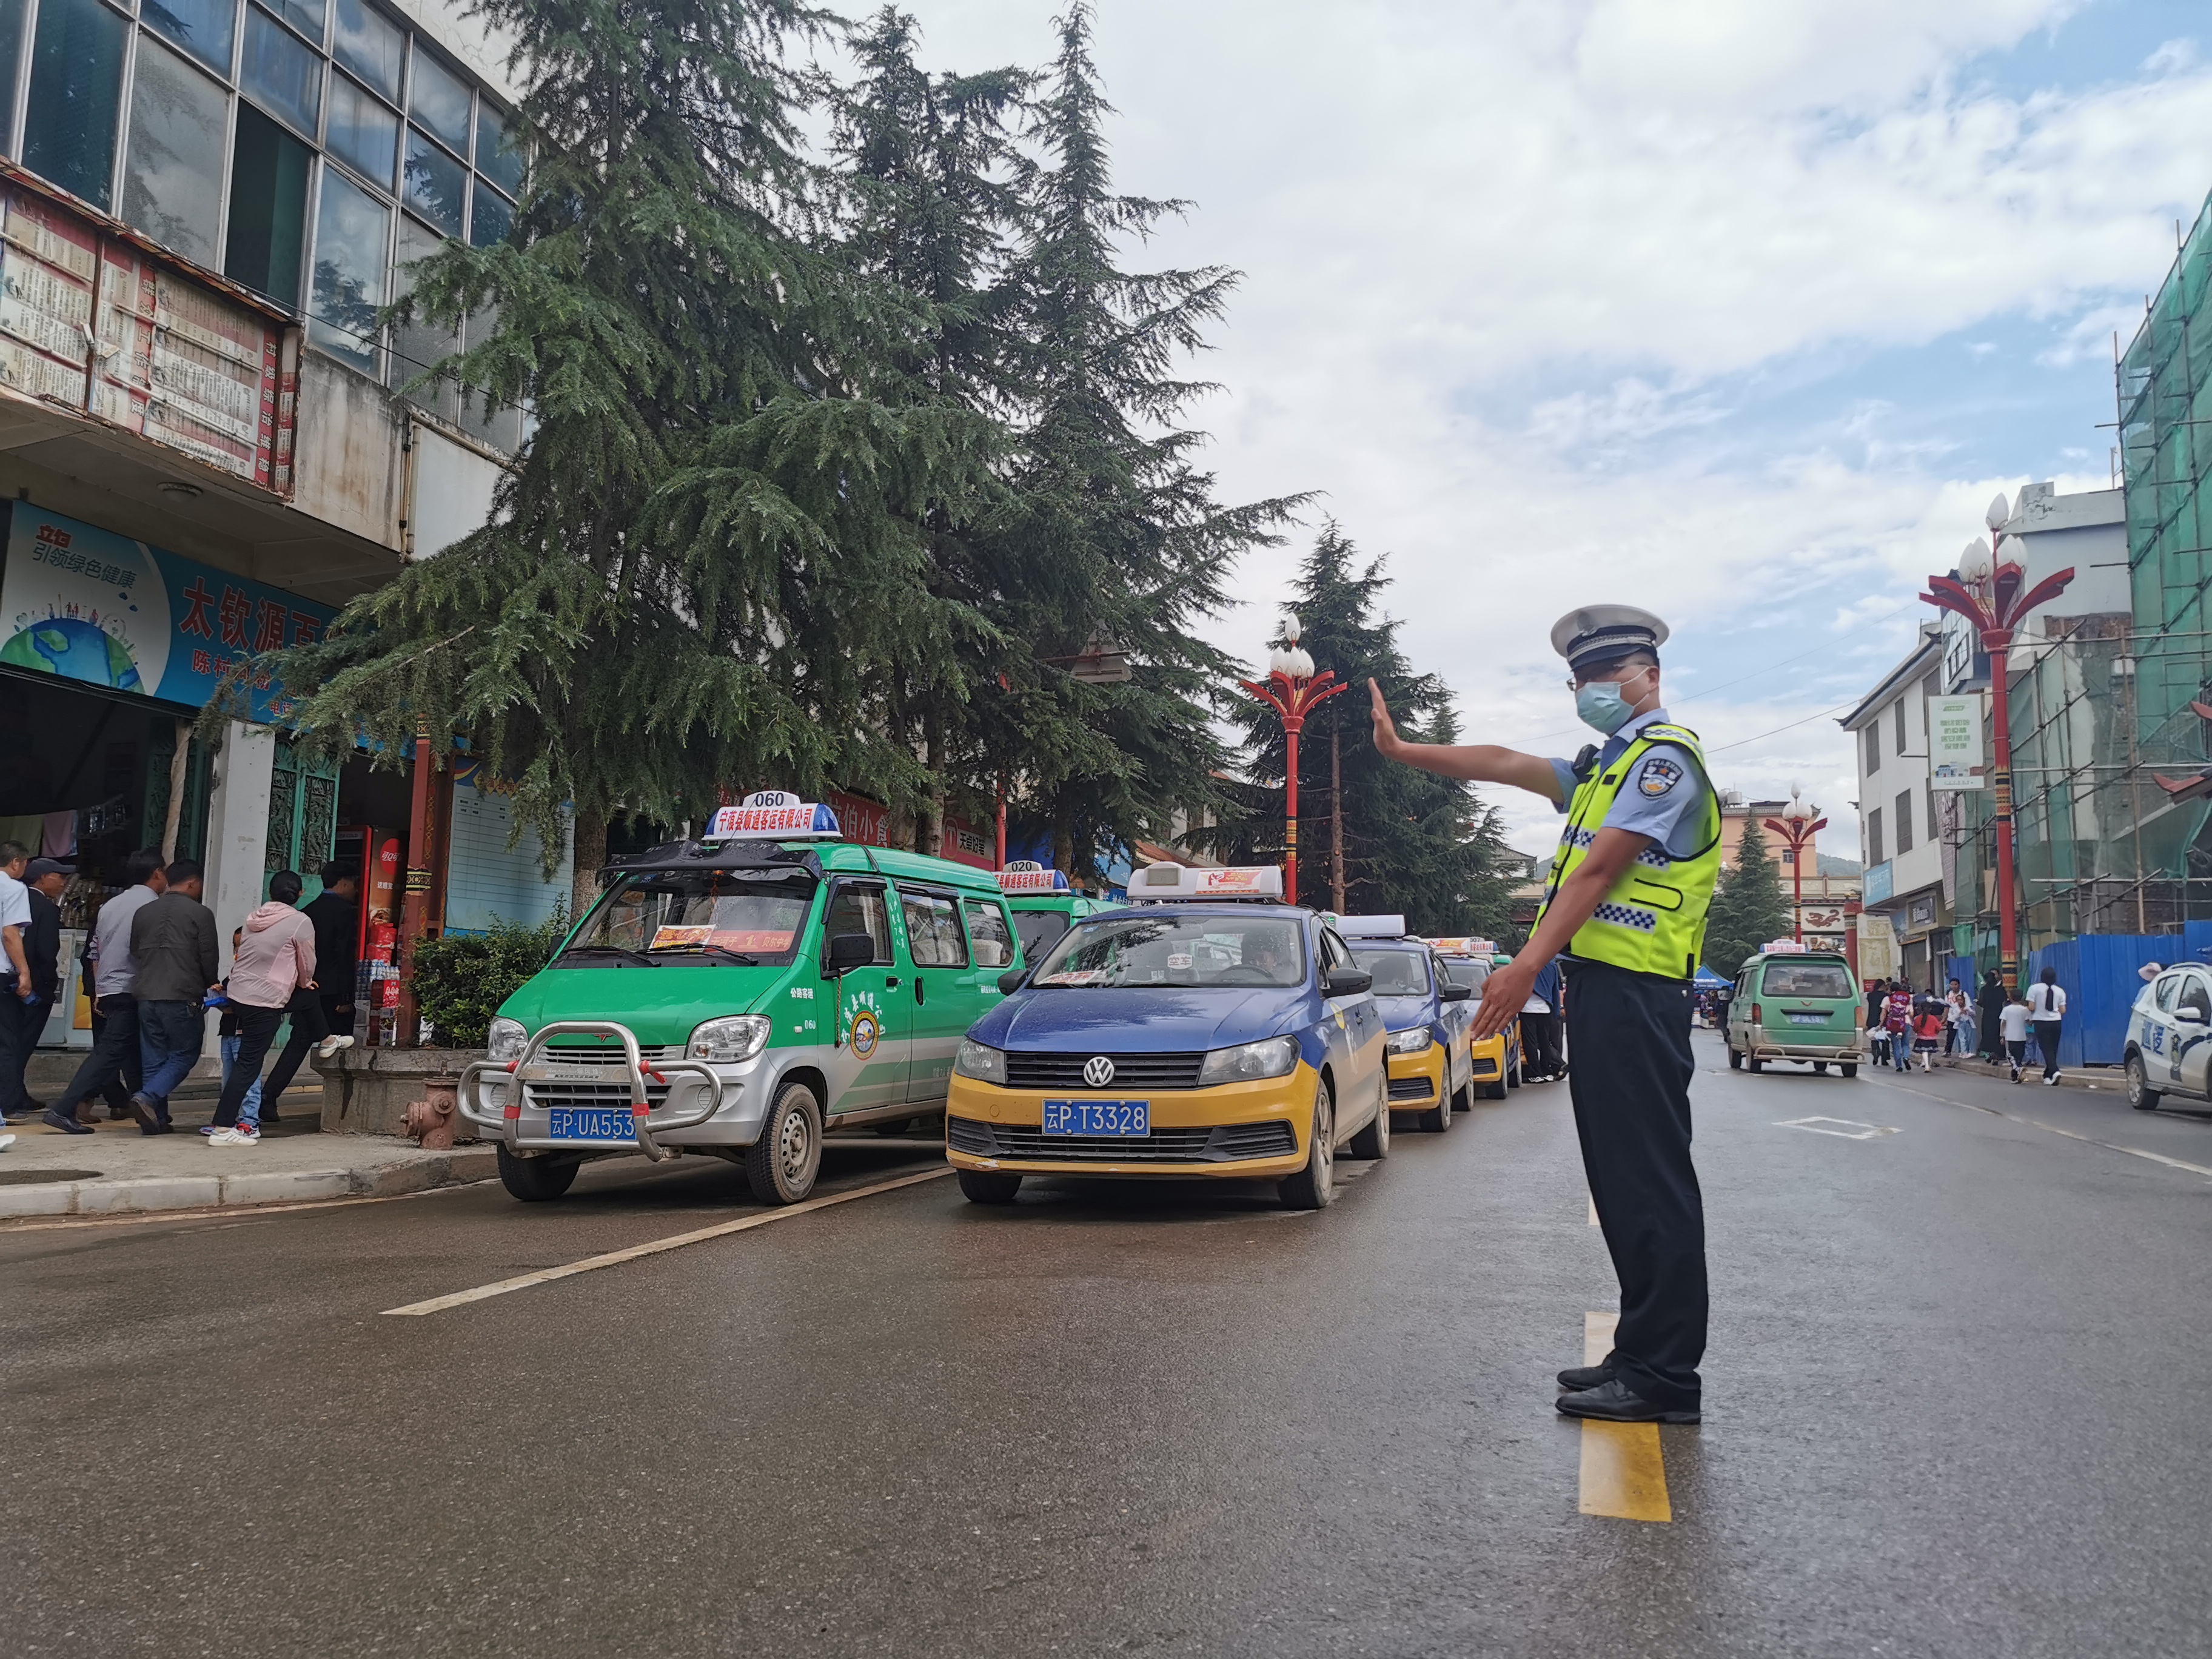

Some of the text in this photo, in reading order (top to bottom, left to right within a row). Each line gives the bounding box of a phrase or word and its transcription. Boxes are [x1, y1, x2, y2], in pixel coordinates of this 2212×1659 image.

[33, 542, 137, 589] 引领绿色健康
[756, 793, 784, 807] 060
[719, 808, 813, 831] 宁蒗县顺通客运有限公司
[1011, 862, 1032, 872] 020
[790, 987, 814, 999] 公路客运
[804, 1019, 816, 1030] 060
